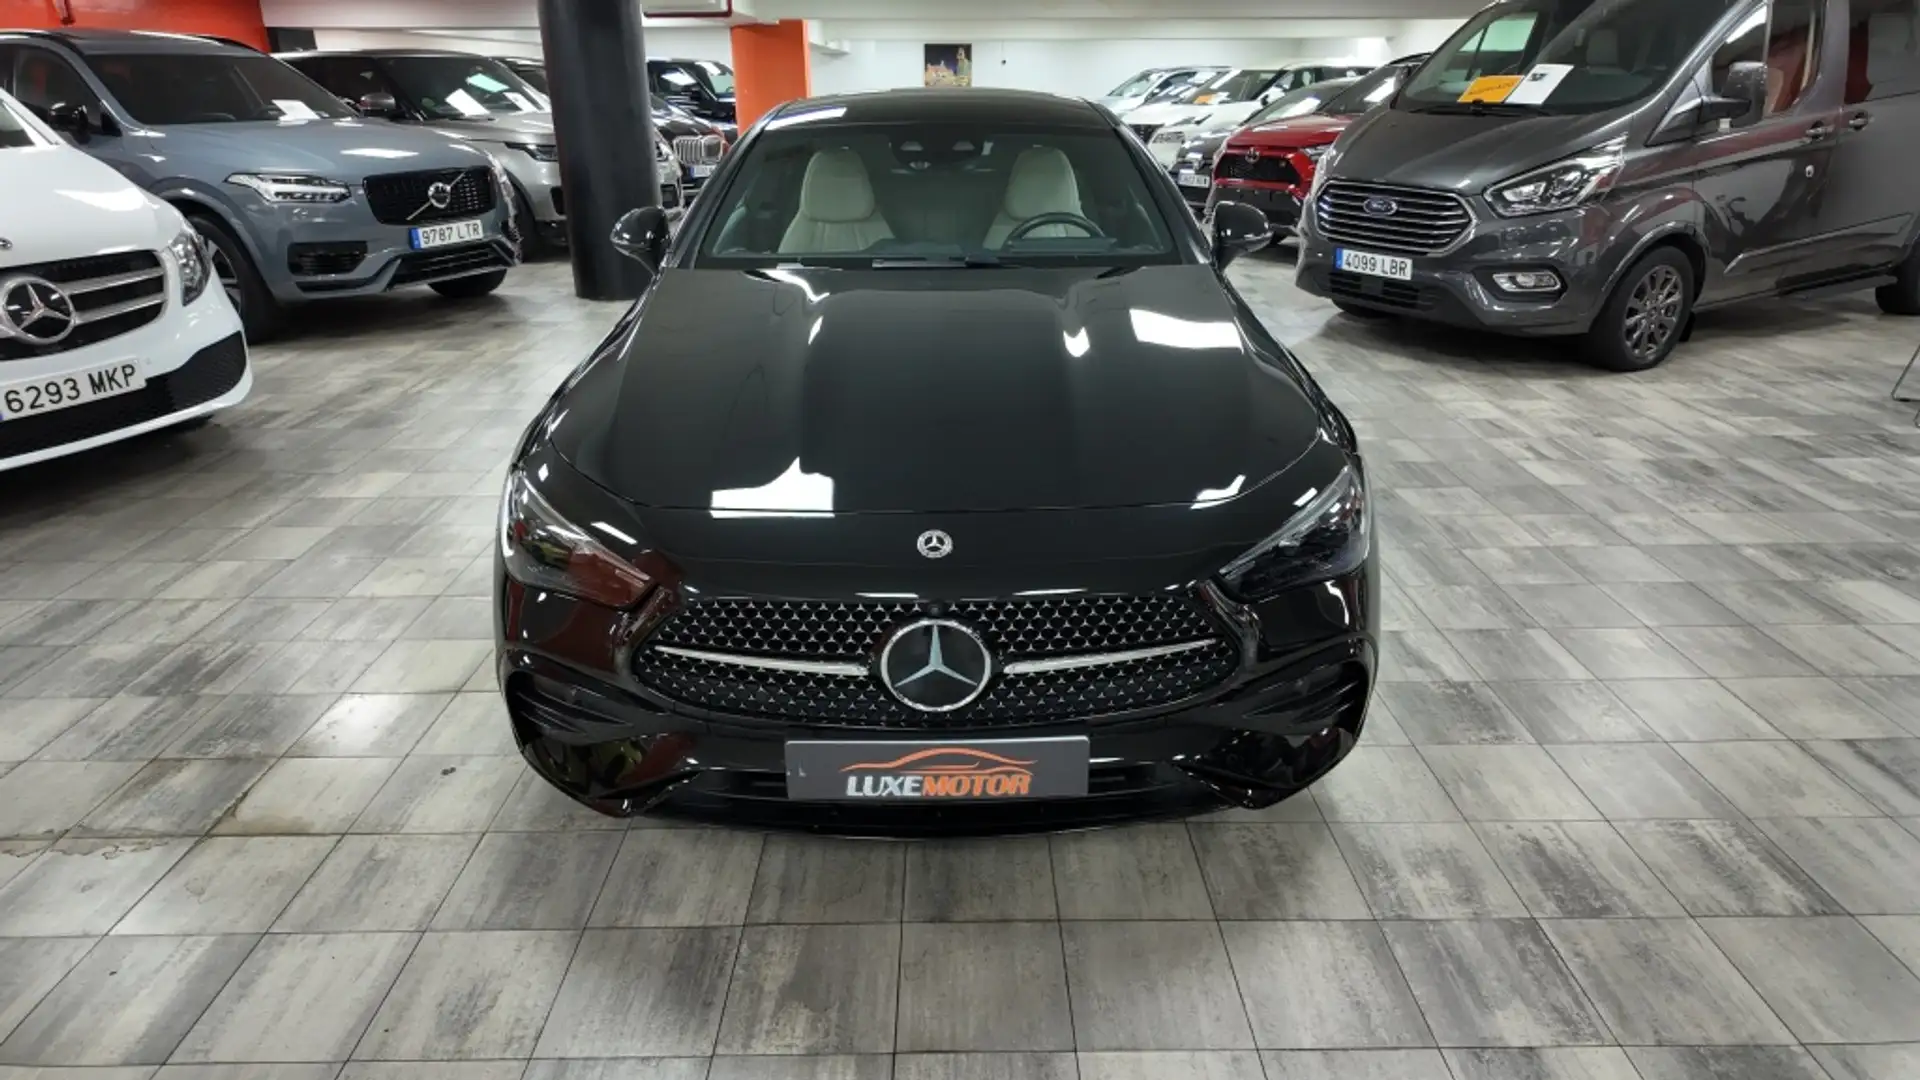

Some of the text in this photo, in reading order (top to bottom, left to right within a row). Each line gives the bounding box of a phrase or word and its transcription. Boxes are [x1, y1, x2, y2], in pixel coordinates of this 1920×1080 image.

[422, 223, 480, 244] 9787 LTR
[1345, 252, 1408, 276] 4099 LBR
[4, 363, 136, 413] 6293 MKP
[846, 774, 1031, 797] LUXEMOTOR
